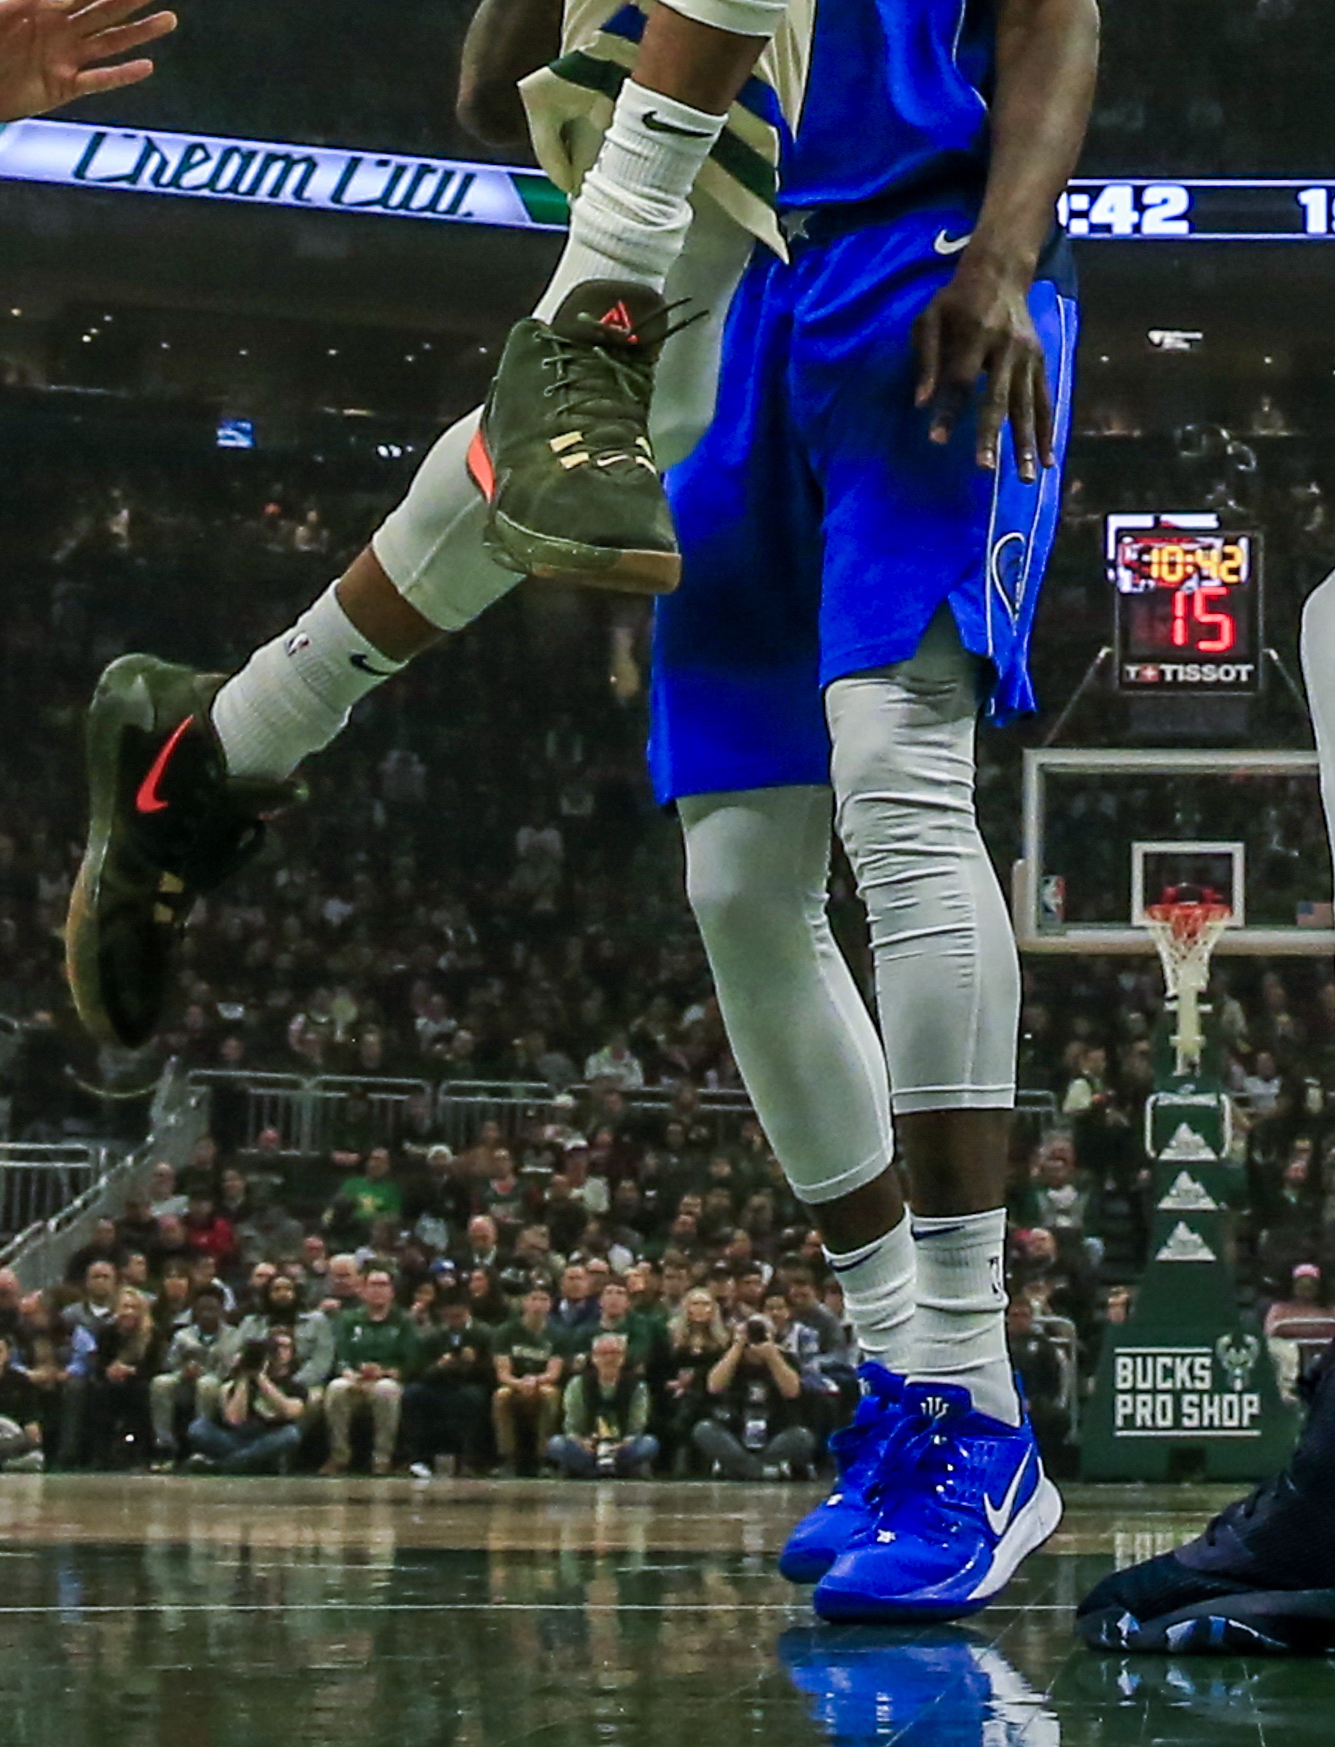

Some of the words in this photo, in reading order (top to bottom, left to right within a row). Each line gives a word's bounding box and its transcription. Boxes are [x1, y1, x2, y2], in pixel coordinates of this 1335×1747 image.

[73, 130, 317, 202] Cream
[1058, 184, 1190, 236] :42
[1150, 545, 1244, 583] 10:42
[1173, 588, 1235, 652] 15
[1160, 665, 1254, 682] TISSOT
[1115, 1356, 1212, 1390] BUCKS
[1115, 1394, 1173, 1427] PRO
[1181, 1394, 1261, 1427] SHOP
